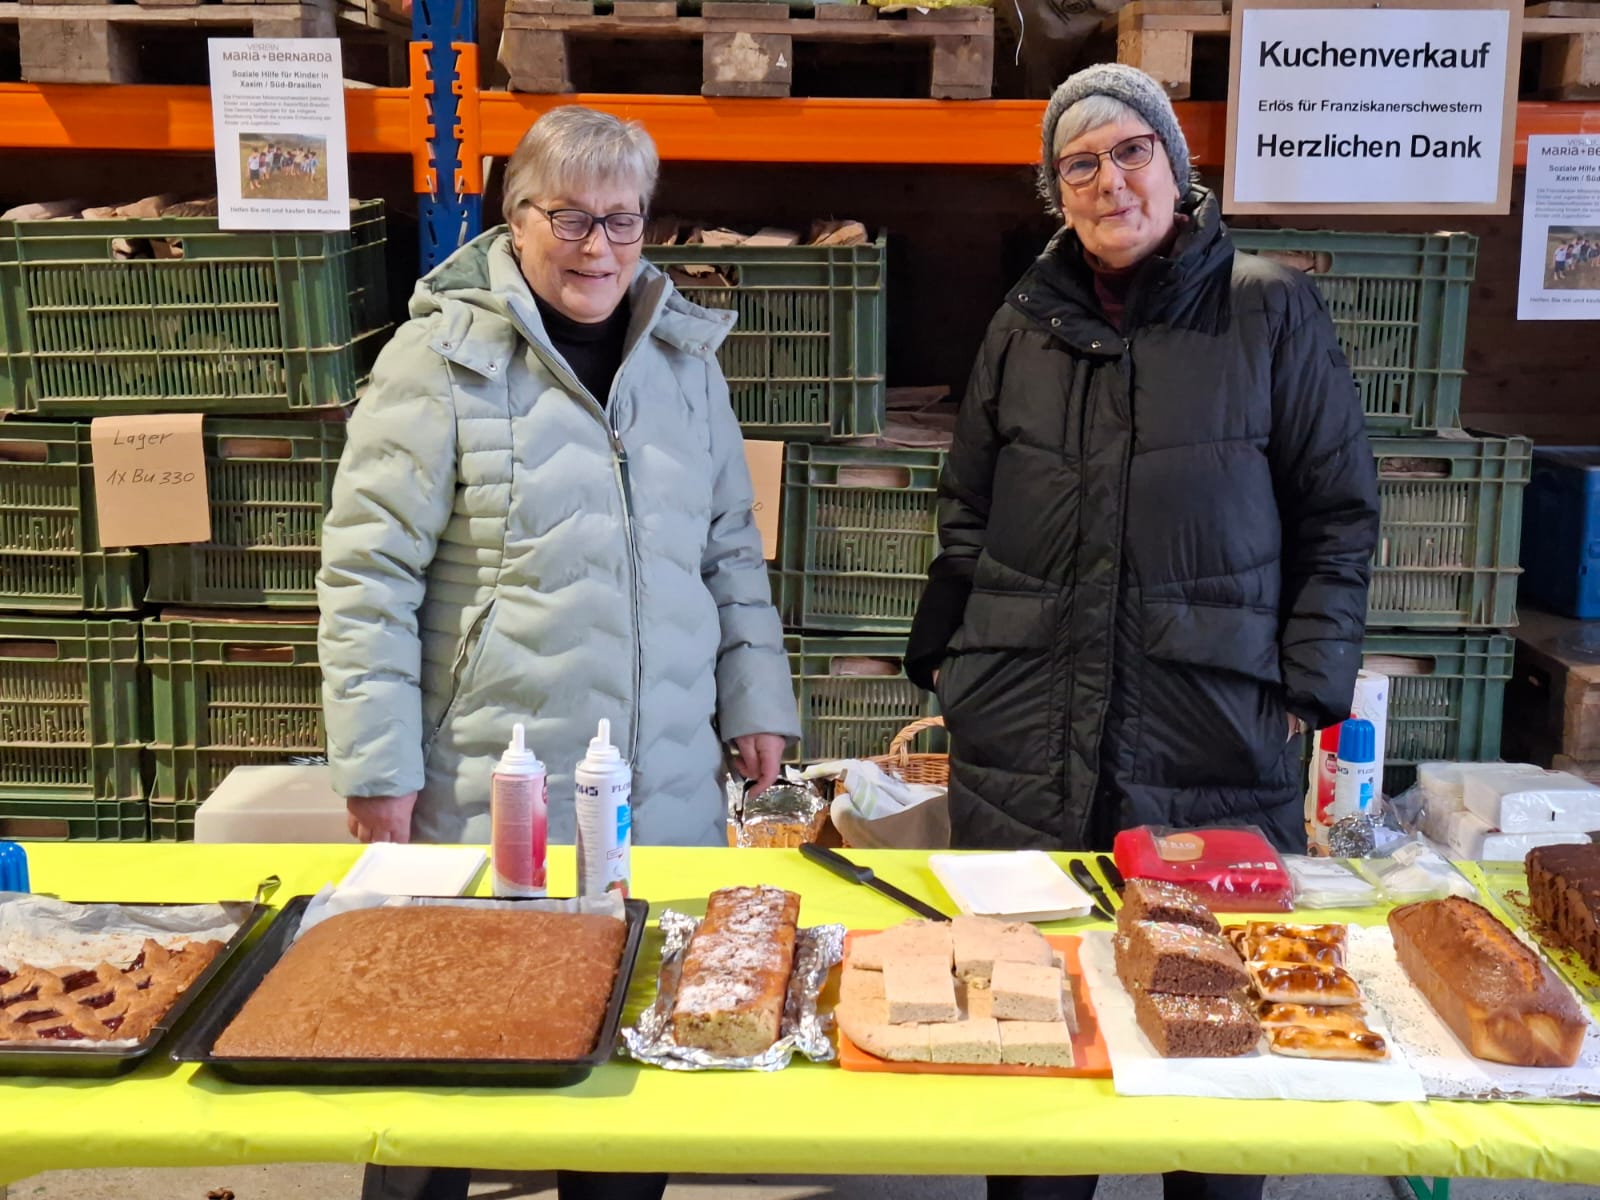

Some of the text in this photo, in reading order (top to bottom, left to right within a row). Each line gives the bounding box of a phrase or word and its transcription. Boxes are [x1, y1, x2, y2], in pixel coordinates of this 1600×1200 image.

[1259, 40, 1491, 68] Kuchenverkauf
[232, 70, 329, 80] Soziale Hilfe für Kinder in
[1258, 99, 1483, 113] Erlös für Franziskanerschwestern
[1257, 133, 1482, 158] Herzlichen Dank
[1549, 164, 1577, 172] Soziale
[113, 429, 174, 451] Lager
[131, 468, 156, 484] Bu
[159, 471, 196, 485] 330
